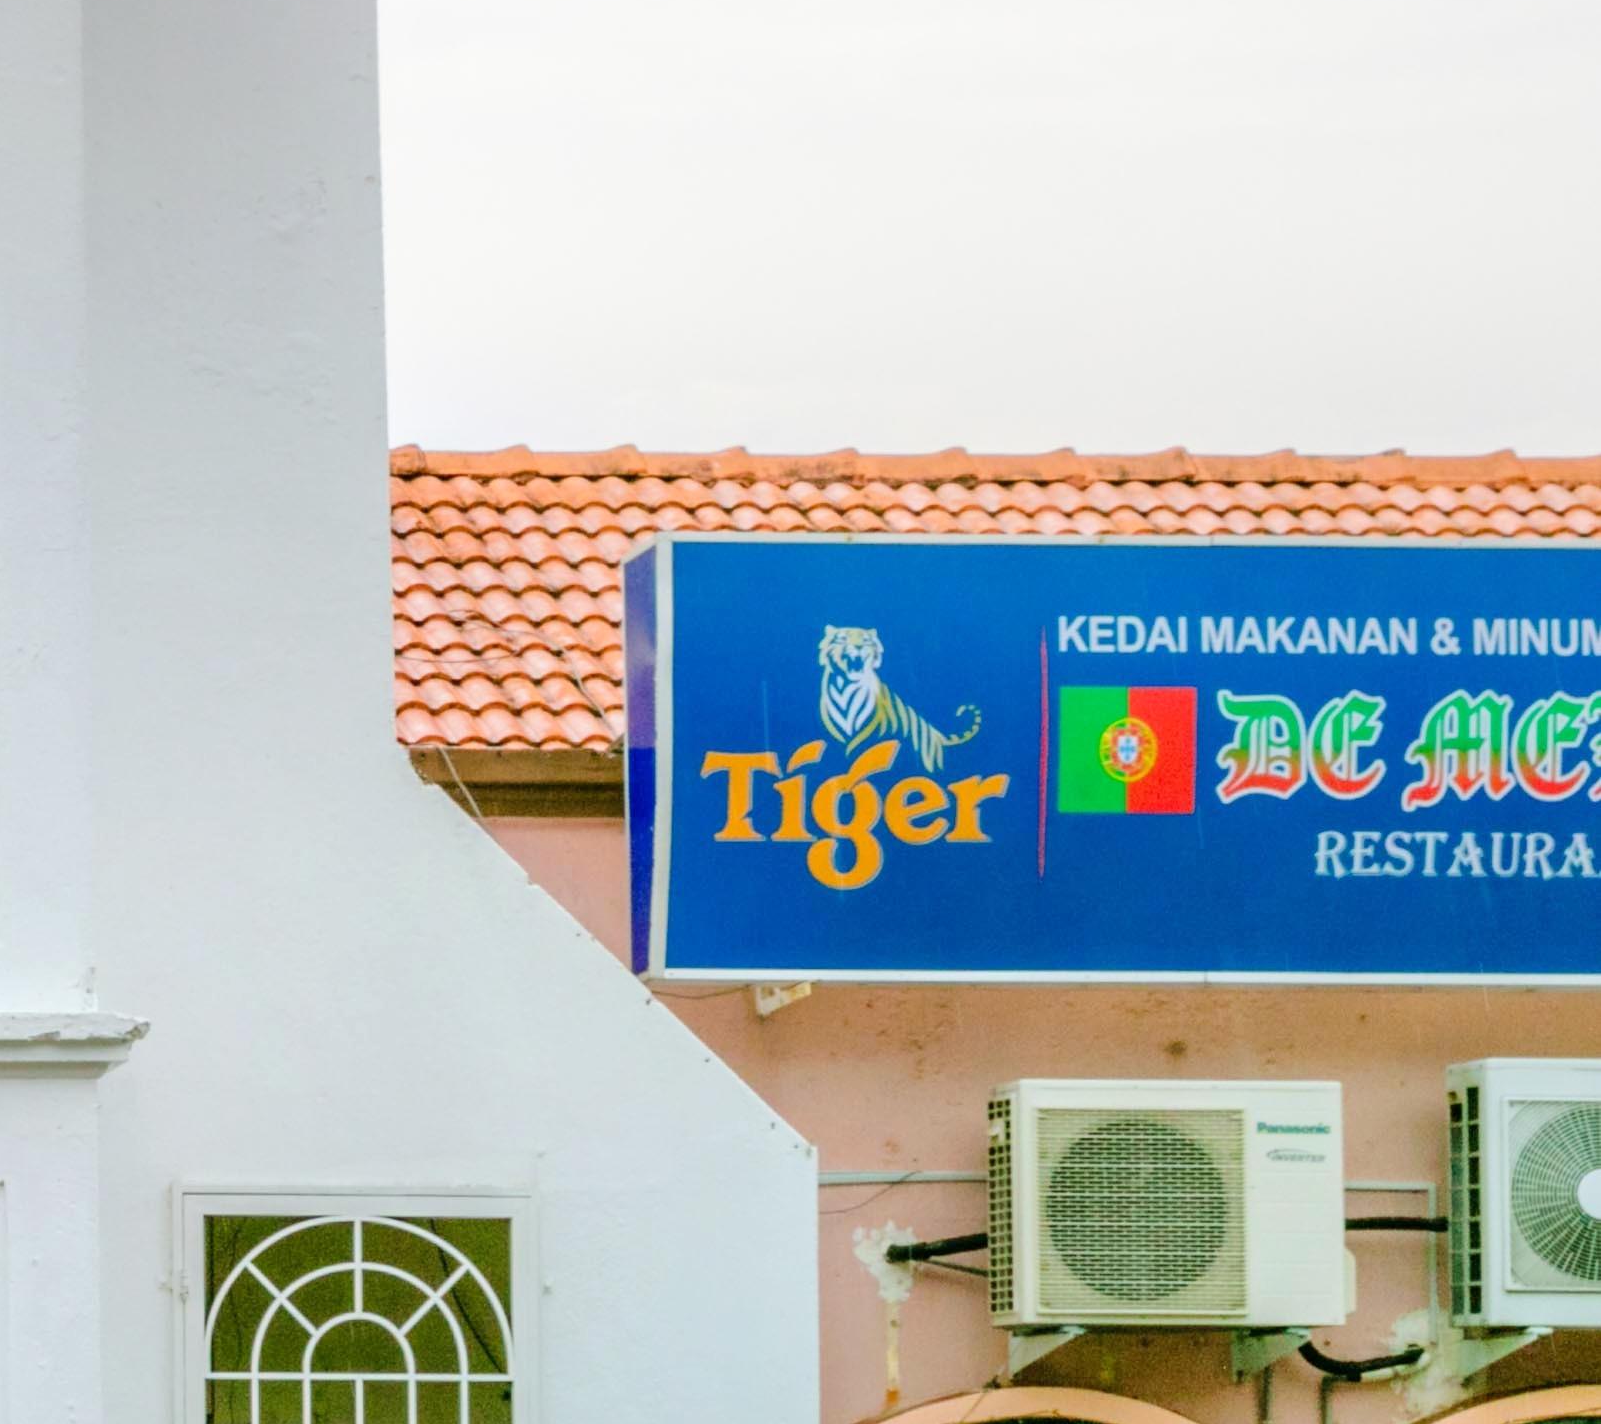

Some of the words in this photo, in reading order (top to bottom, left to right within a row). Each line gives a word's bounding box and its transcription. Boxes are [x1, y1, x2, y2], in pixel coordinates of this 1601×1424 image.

[1058, 616, 1187, 653] KEDAI
[1201, 617, 1417, 655] MAKANAN
[1431, 618, 1461, 656] &
[1217, 689, 1386, 804] DE
[1402, 689, 1601, 812] ME
[702, 740, 1008, 889] Tiger
[1315, 830, 1601, 879] RESTAURA
[1257, 1122, 1330, 1134] Panasonic
